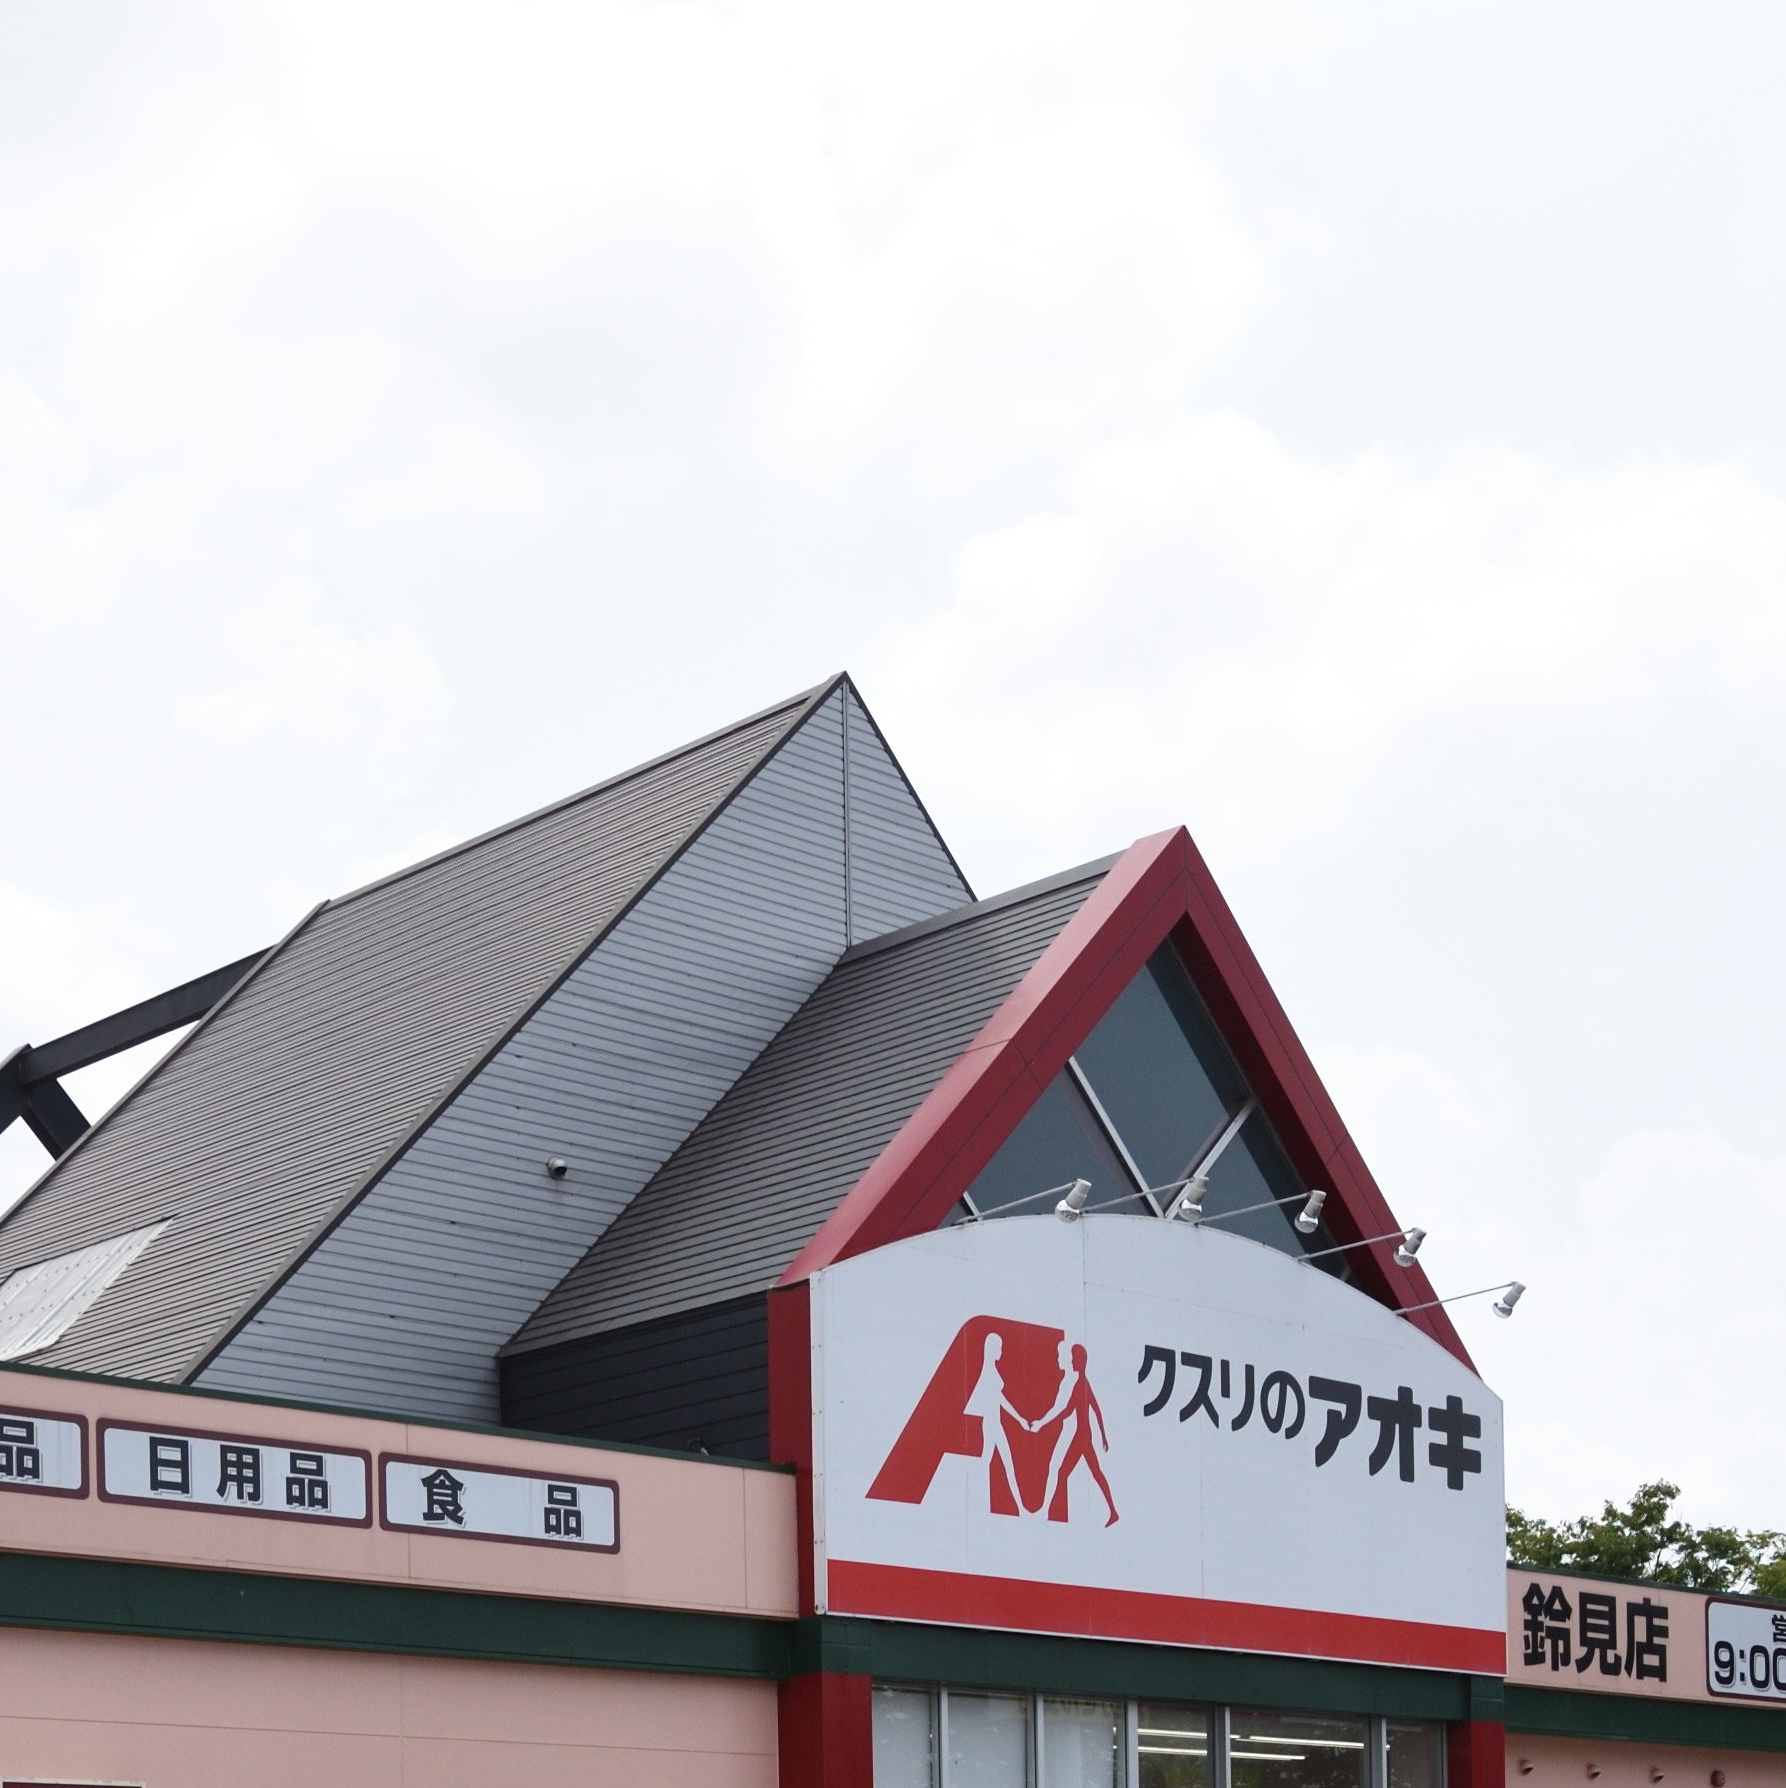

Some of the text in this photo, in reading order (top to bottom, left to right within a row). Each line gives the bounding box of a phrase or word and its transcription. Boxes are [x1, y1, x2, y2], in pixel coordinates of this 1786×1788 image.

[1138, 1344, 1482, 1491] クスリのアオキ
[150, 1437, 330, 1510] 日用品
[419, 1467, 583, 1540] 食品
[1521, 1582, 1669, 1683] 鈴見店
